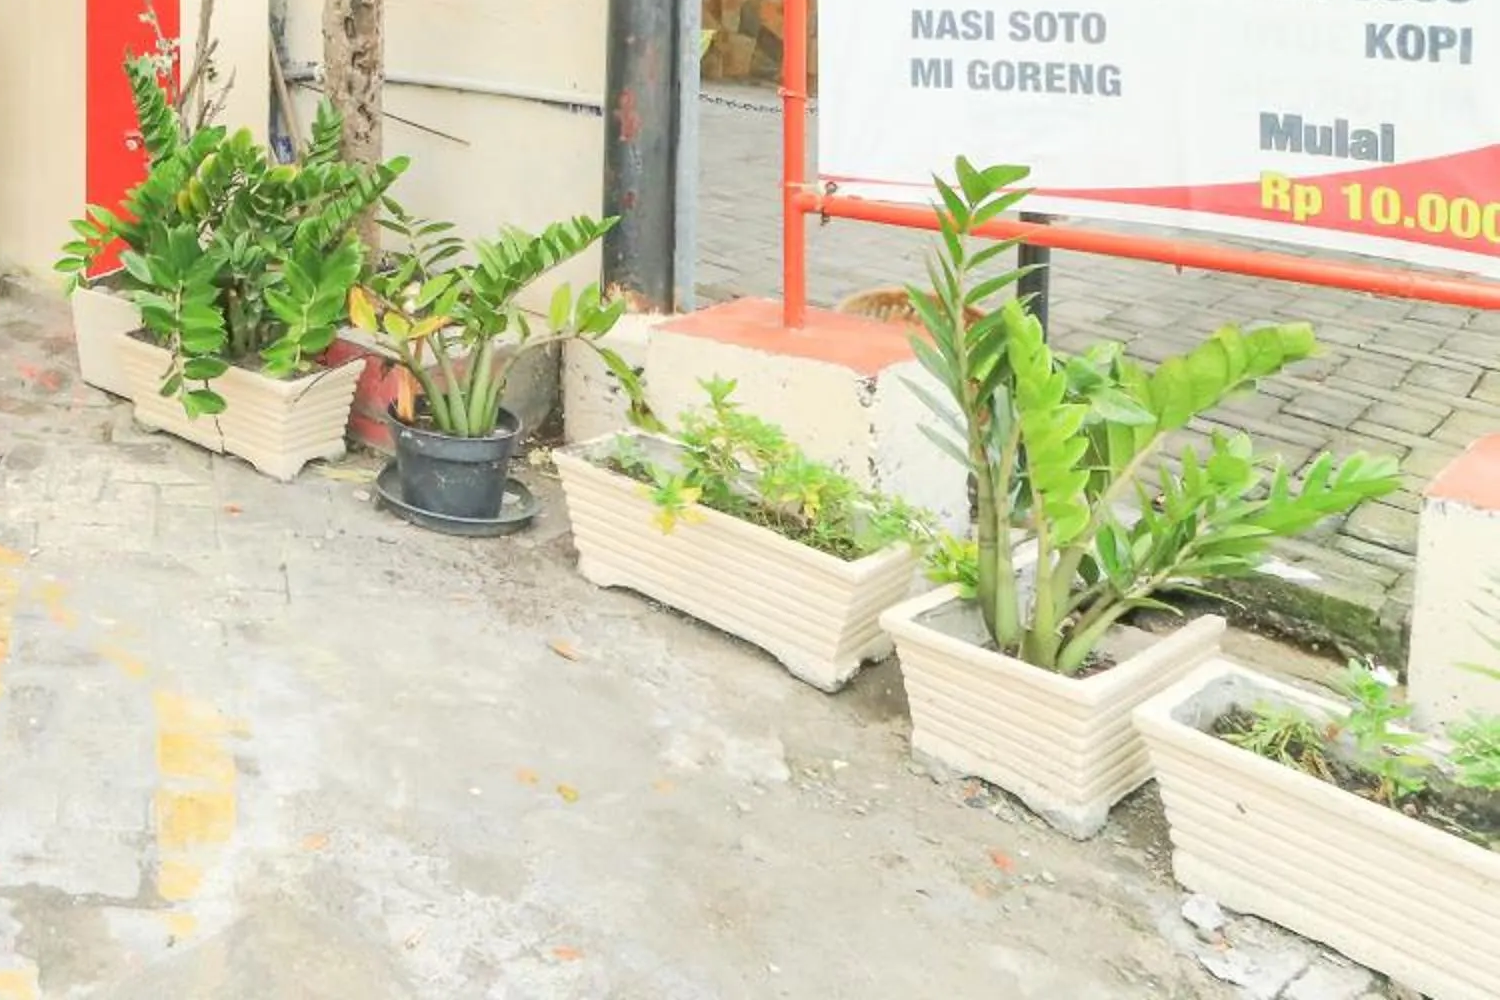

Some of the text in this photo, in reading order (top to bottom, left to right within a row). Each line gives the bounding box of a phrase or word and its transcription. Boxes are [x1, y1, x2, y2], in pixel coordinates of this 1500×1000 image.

[910, 10, 1107, 45] NASI SOTO
[1364, 23, 1473, 65] KOPI
[910, 58, 1122, 97] MI GORENG
[1259, 111, 1395, 163] Mulai
[1260, 170, 1500, 243] Rp 10.000
